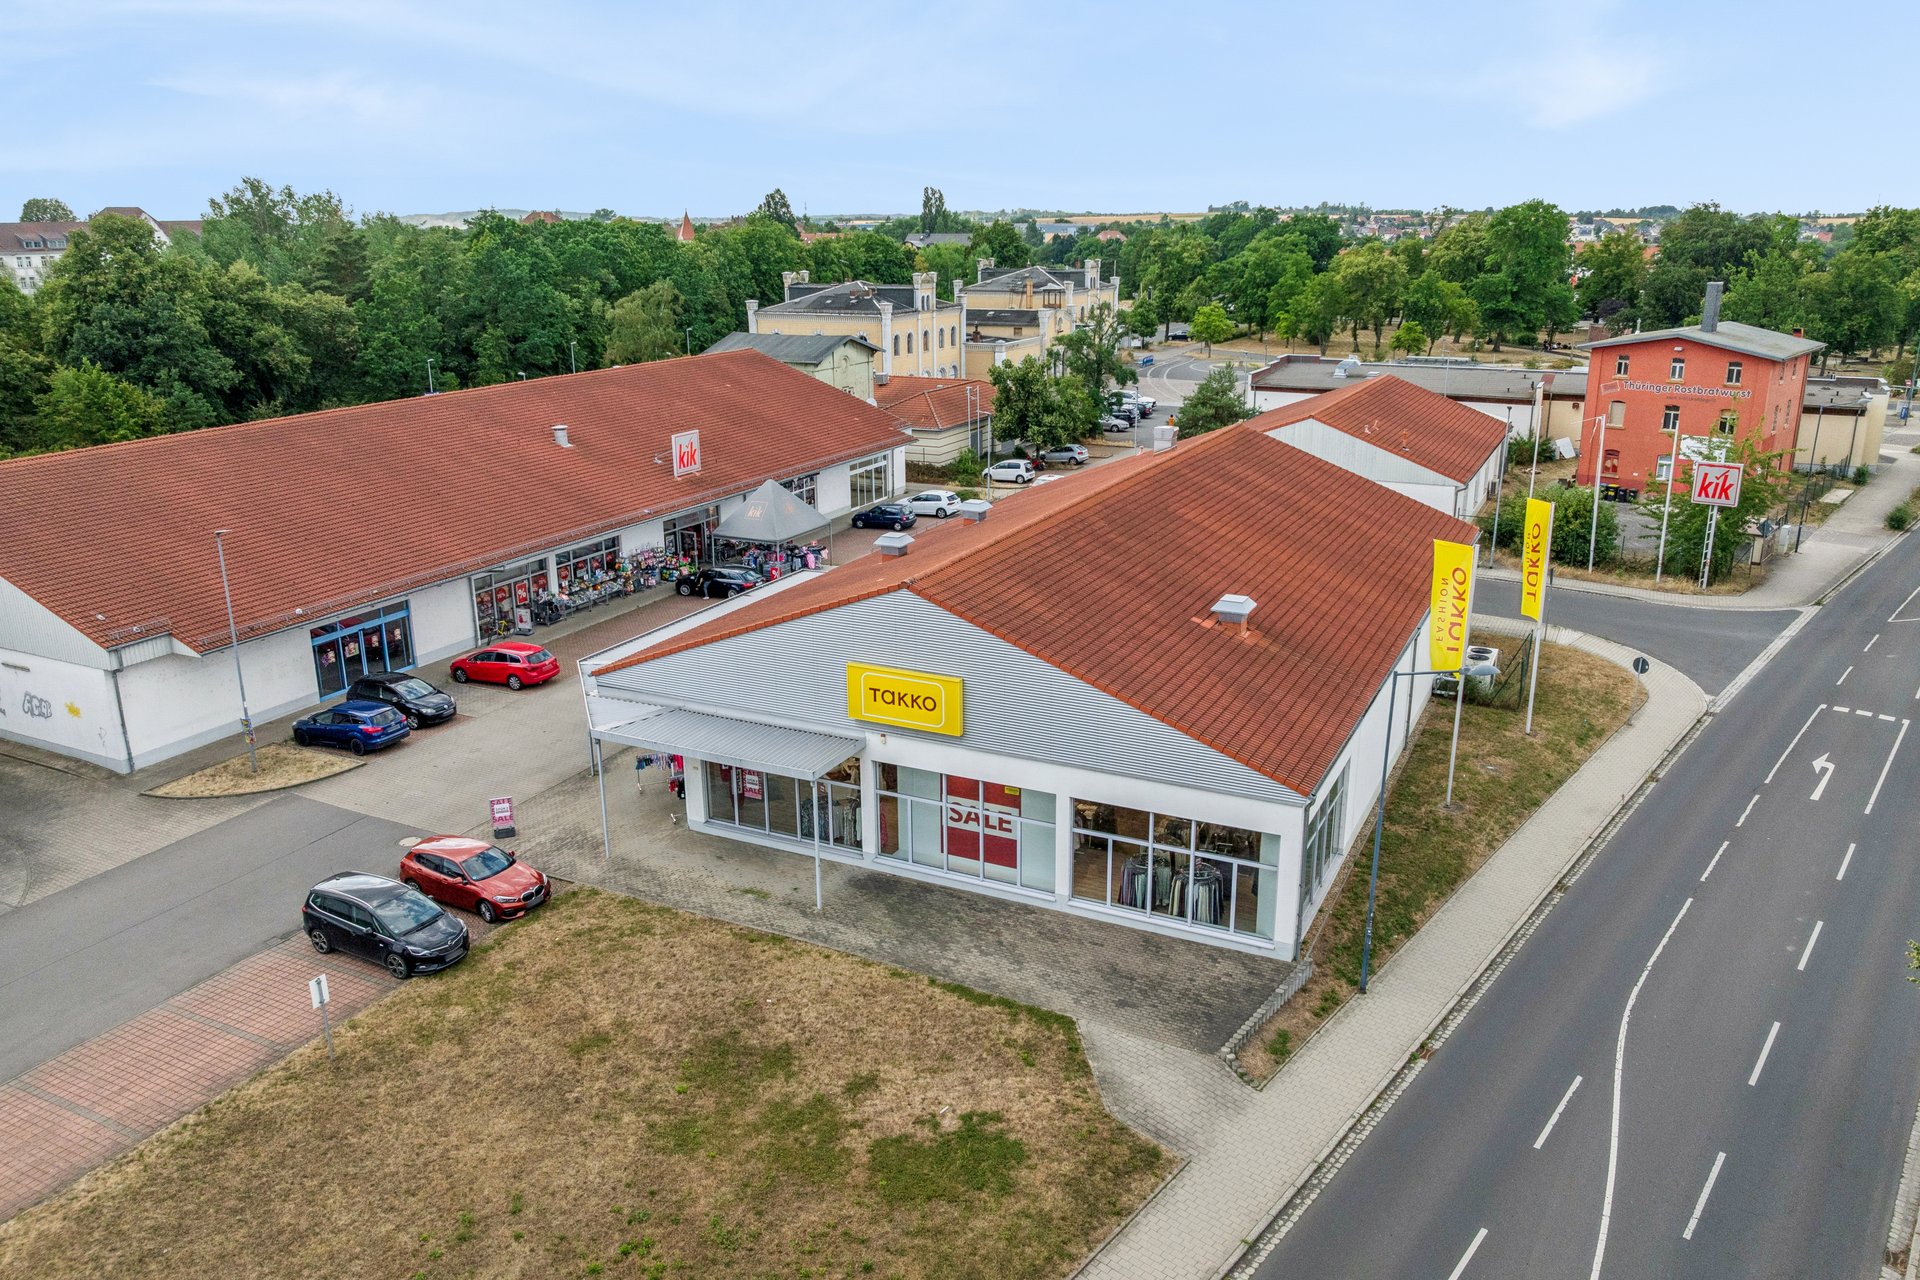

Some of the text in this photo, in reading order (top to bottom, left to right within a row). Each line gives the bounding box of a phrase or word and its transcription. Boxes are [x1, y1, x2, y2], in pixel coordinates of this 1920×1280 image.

[1623, 380, 1752, 399] Thüringer Rostbratwurst
[948, 801, 1013, 834] SALE
